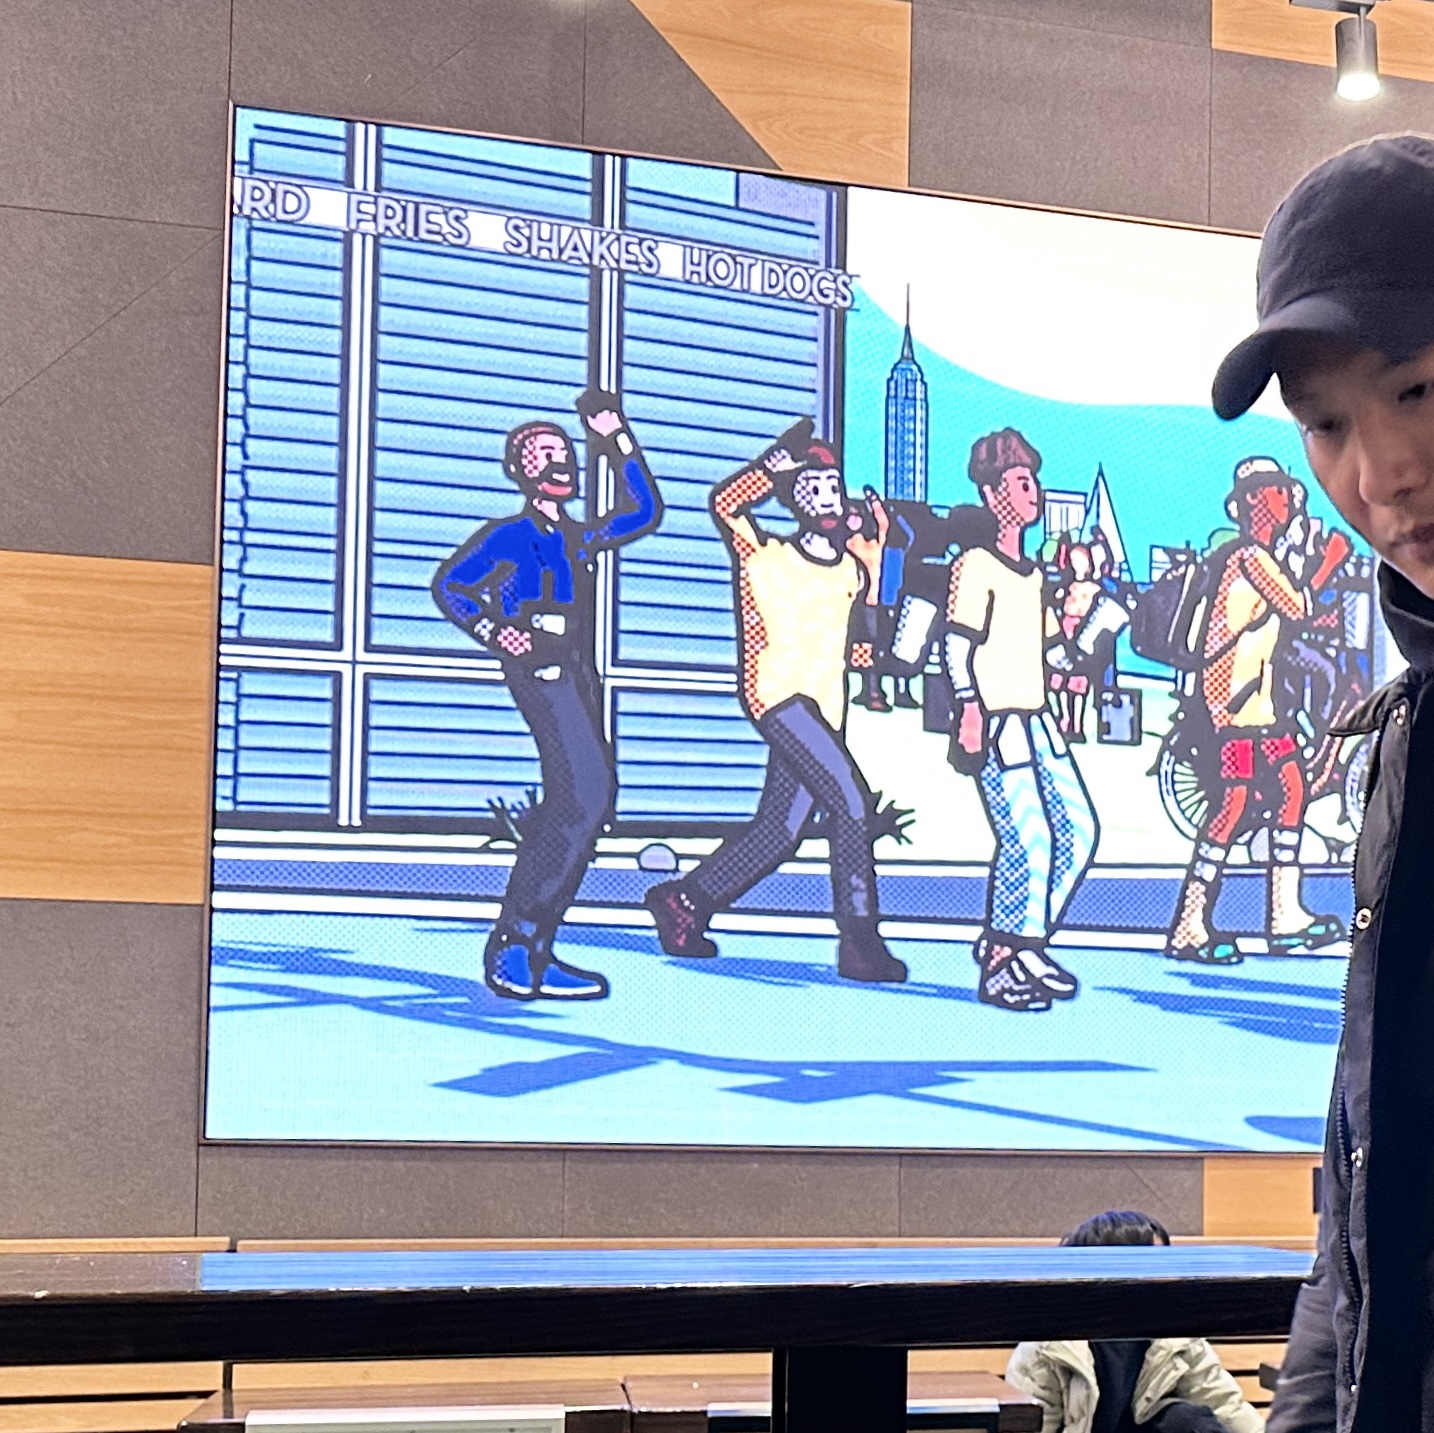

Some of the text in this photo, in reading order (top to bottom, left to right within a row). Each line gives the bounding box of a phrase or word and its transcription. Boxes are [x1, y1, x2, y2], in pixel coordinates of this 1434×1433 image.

[233, 177, 311, 222] RD
[348, 193, 471, 247] FRIES
[503, 217, 661, 276] SHAKES
